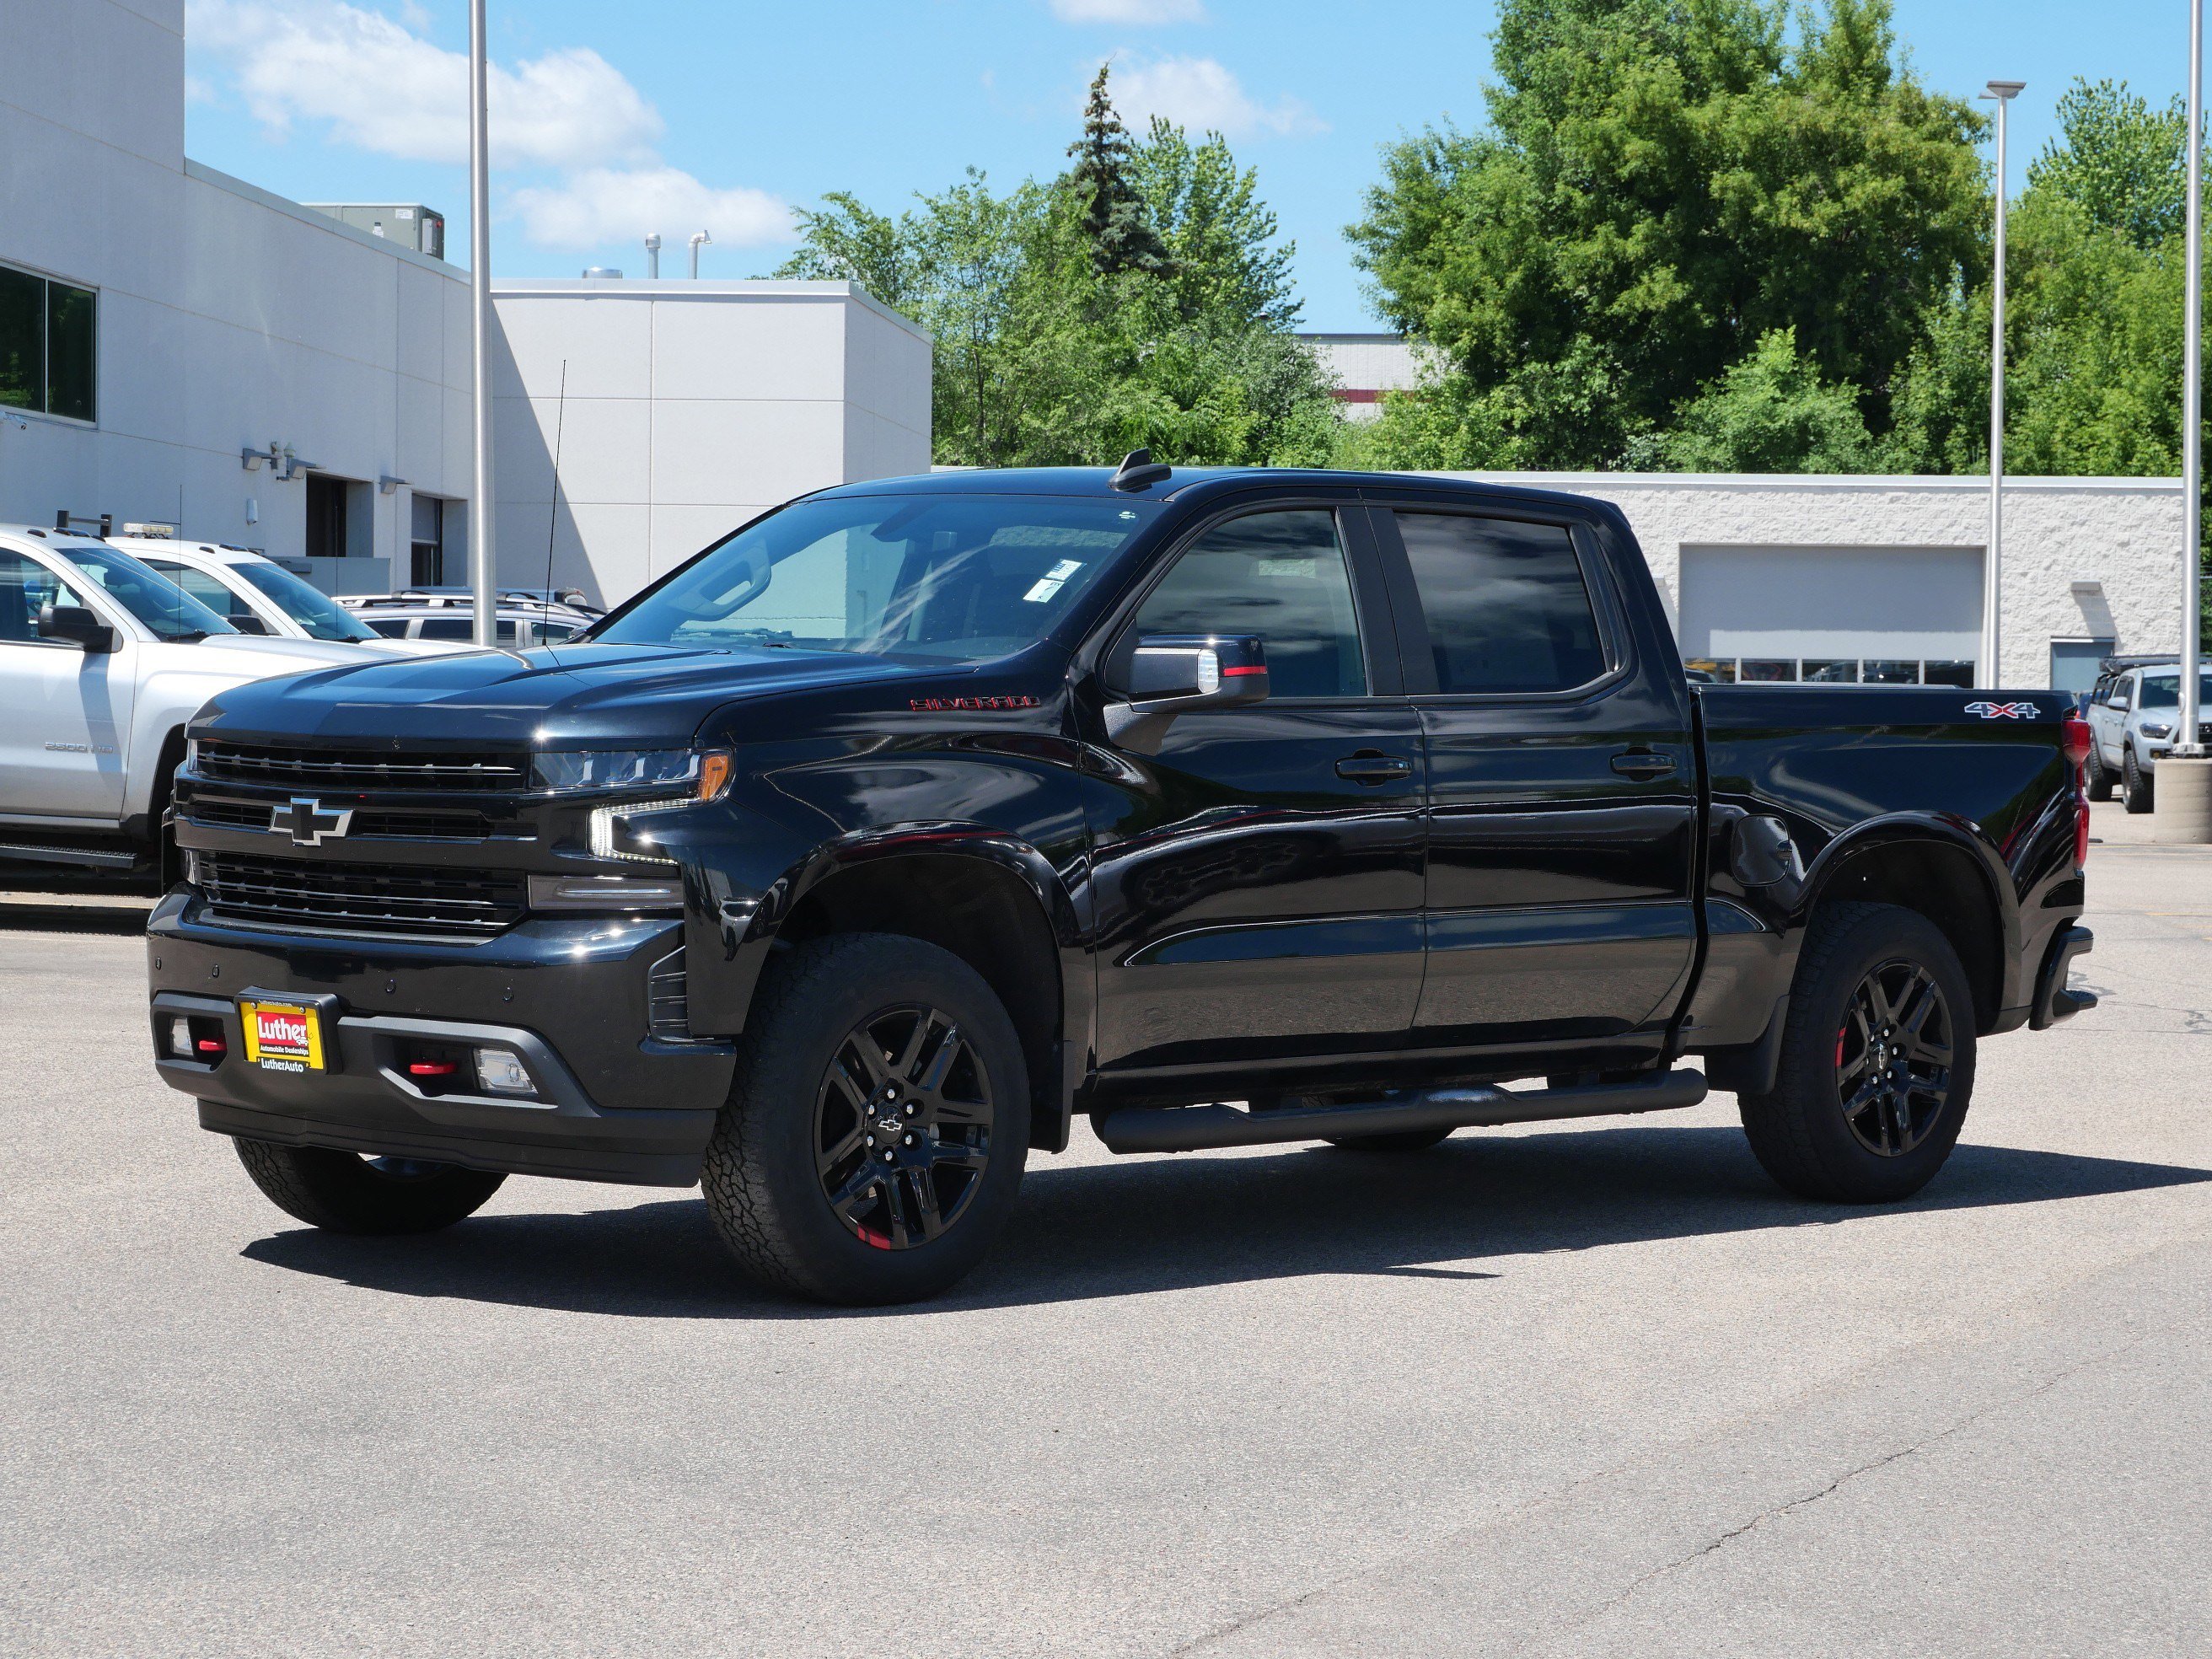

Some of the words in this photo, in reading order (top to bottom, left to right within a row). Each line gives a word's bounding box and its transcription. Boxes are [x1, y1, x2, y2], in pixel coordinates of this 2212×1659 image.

[910, 695, 1042, 711] SILVERADO
[45, 742, 88, 754] 2500
[257, 1016, 307, 1041] Luther
[285, 1047, 309, 1055] Dealerships
[261, 1057, 304, 1073] LutherAuto
